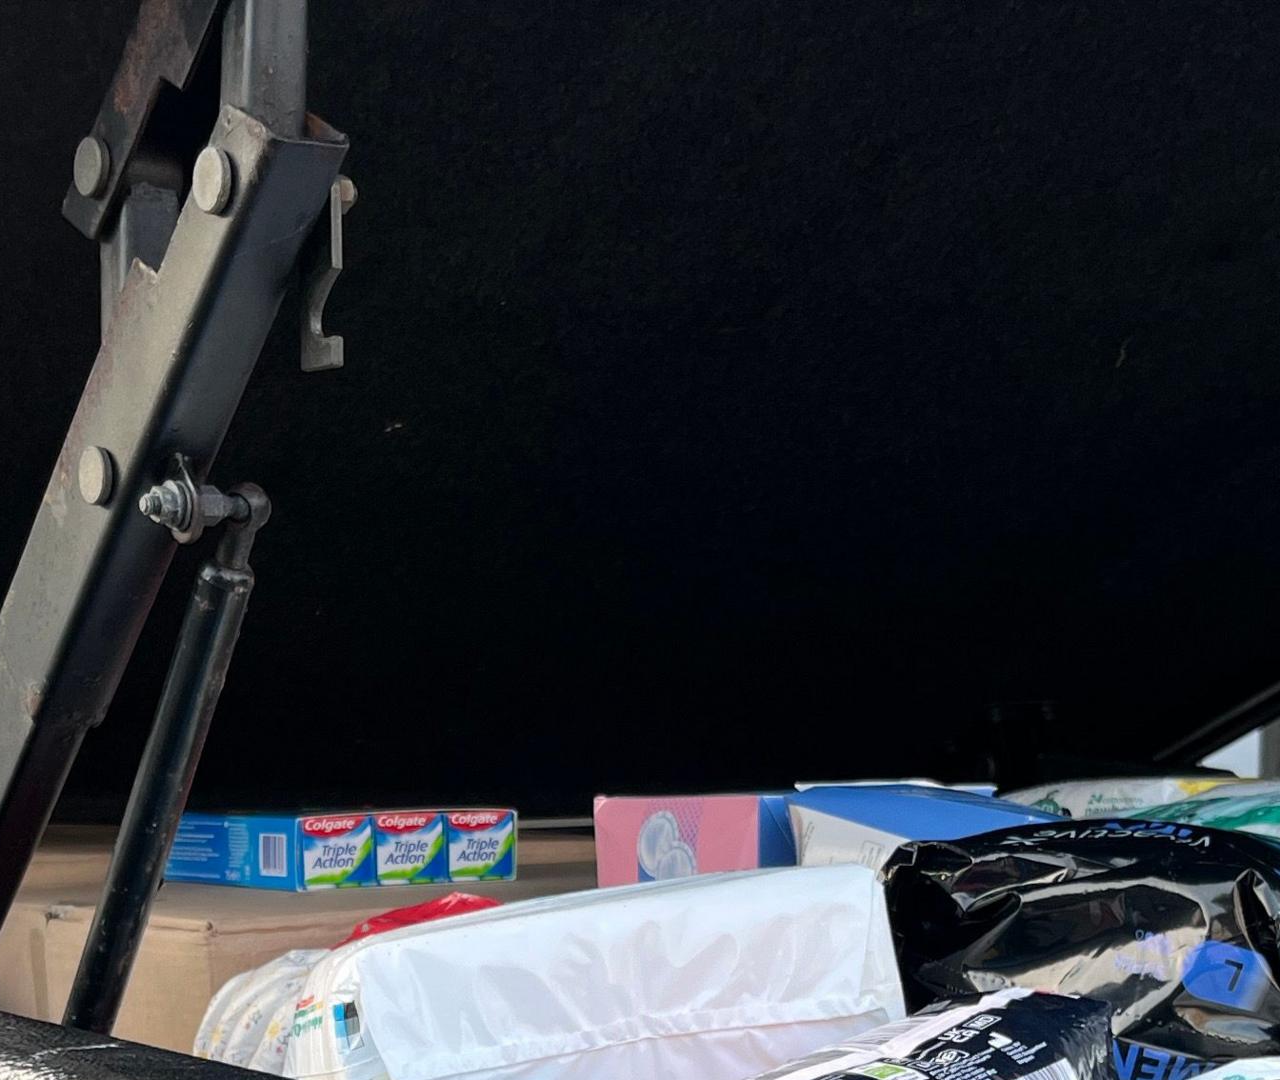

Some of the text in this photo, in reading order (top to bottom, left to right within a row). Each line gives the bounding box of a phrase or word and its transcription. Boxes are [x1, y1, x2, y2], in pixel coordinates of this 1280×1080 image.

[304, 818, 356, 833] Colgate
[377, 814, 427, 829] Colgate
[451, 812, 499, 827] Colgate
[322, 843, 357, 858] Triple
[394, 839, 429, 854] Triple
[466, 837, 500, 852] Triple
[312, 855, 355, 869] Action
[384, 852, 426, 865] Action
[456, 849, 497, 863] Action
